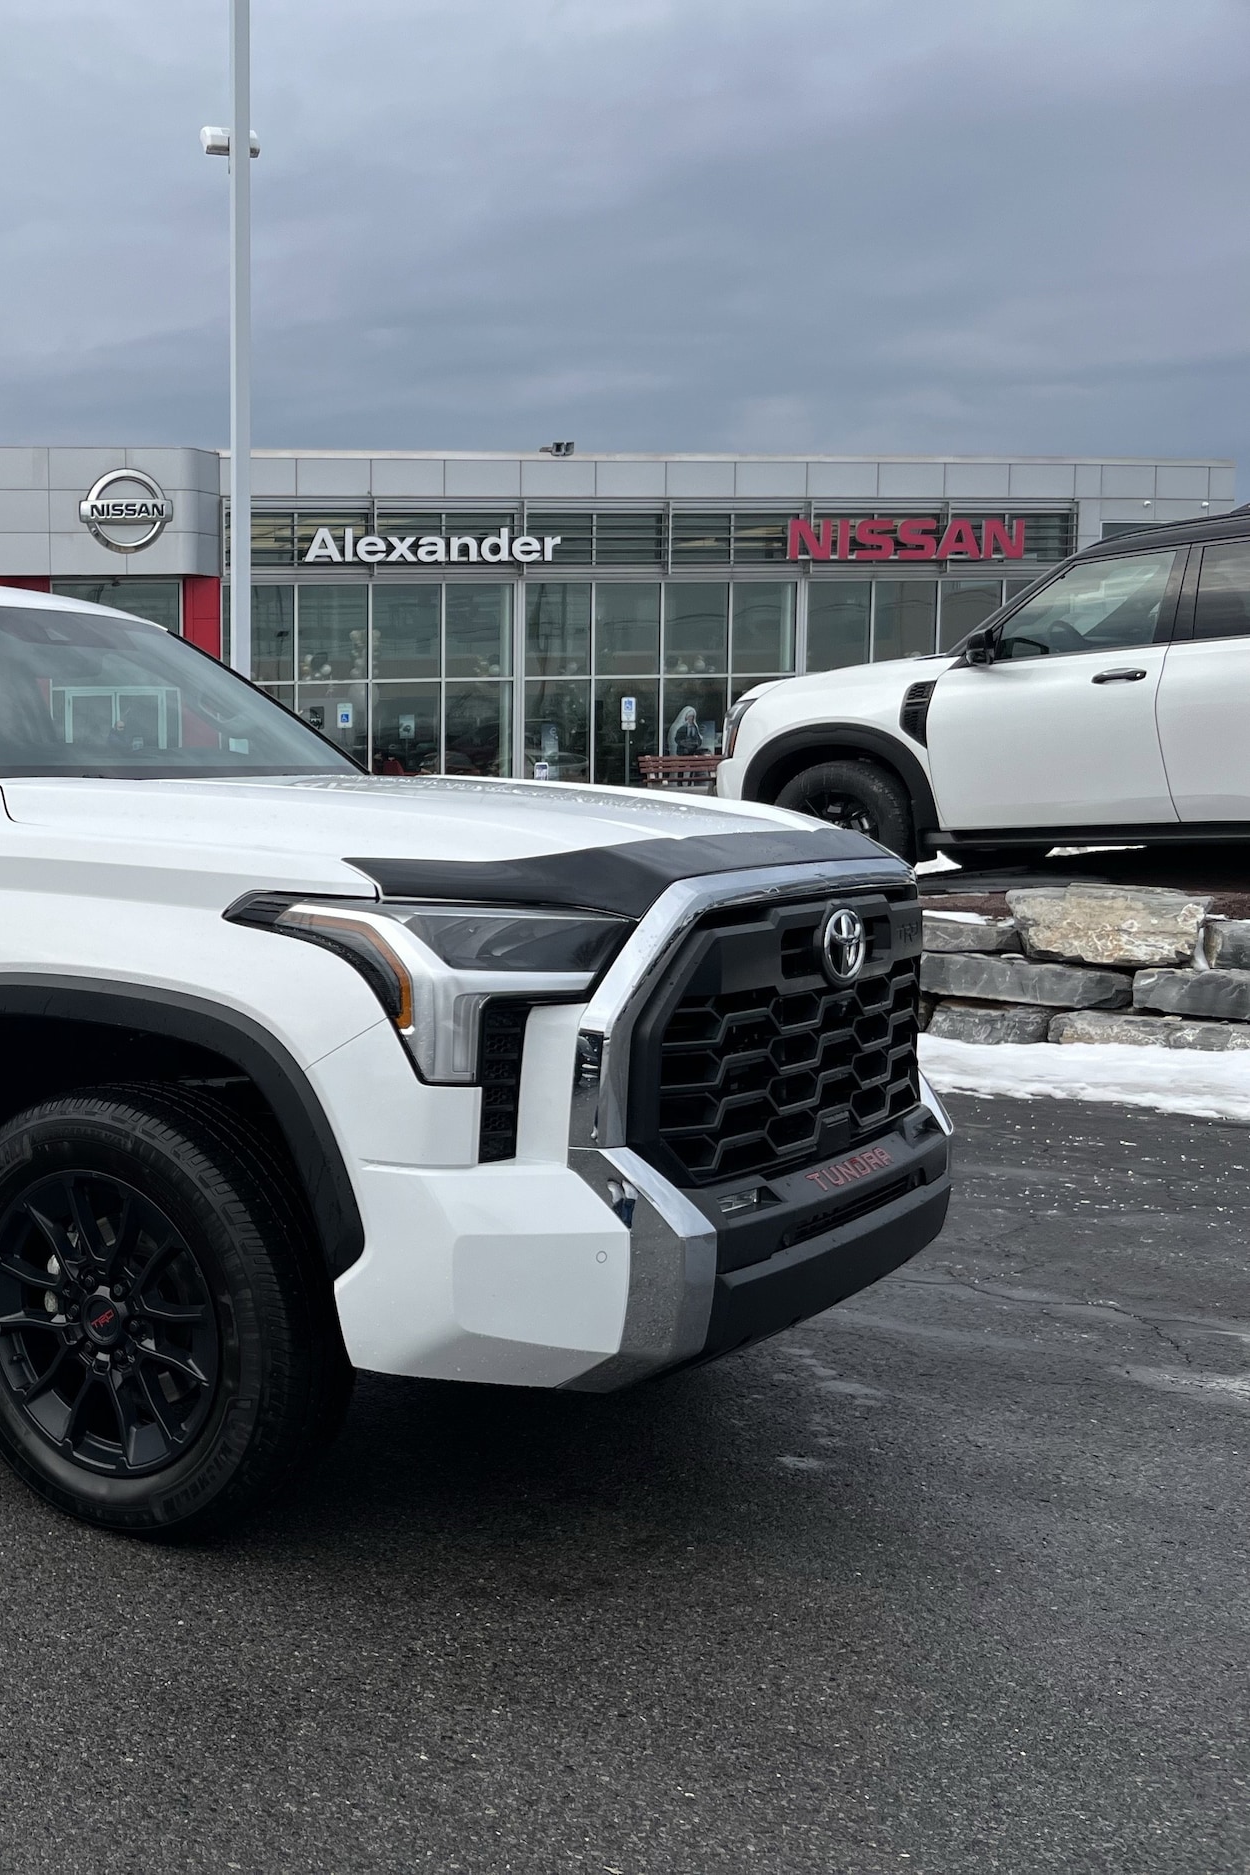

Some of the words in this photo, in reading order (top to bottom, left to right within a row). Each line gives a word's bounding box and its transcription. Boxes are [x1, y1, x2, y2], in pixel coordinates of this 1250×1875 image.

[90, 503, 165, 518] NISSAN
[303, 527, 562, 563] Alexander
[786, 518, 1026, 560] NISSAN
[805, 1147, 894, 1192] TUNDRA
[90, 1308, 115, 1329] TRD
